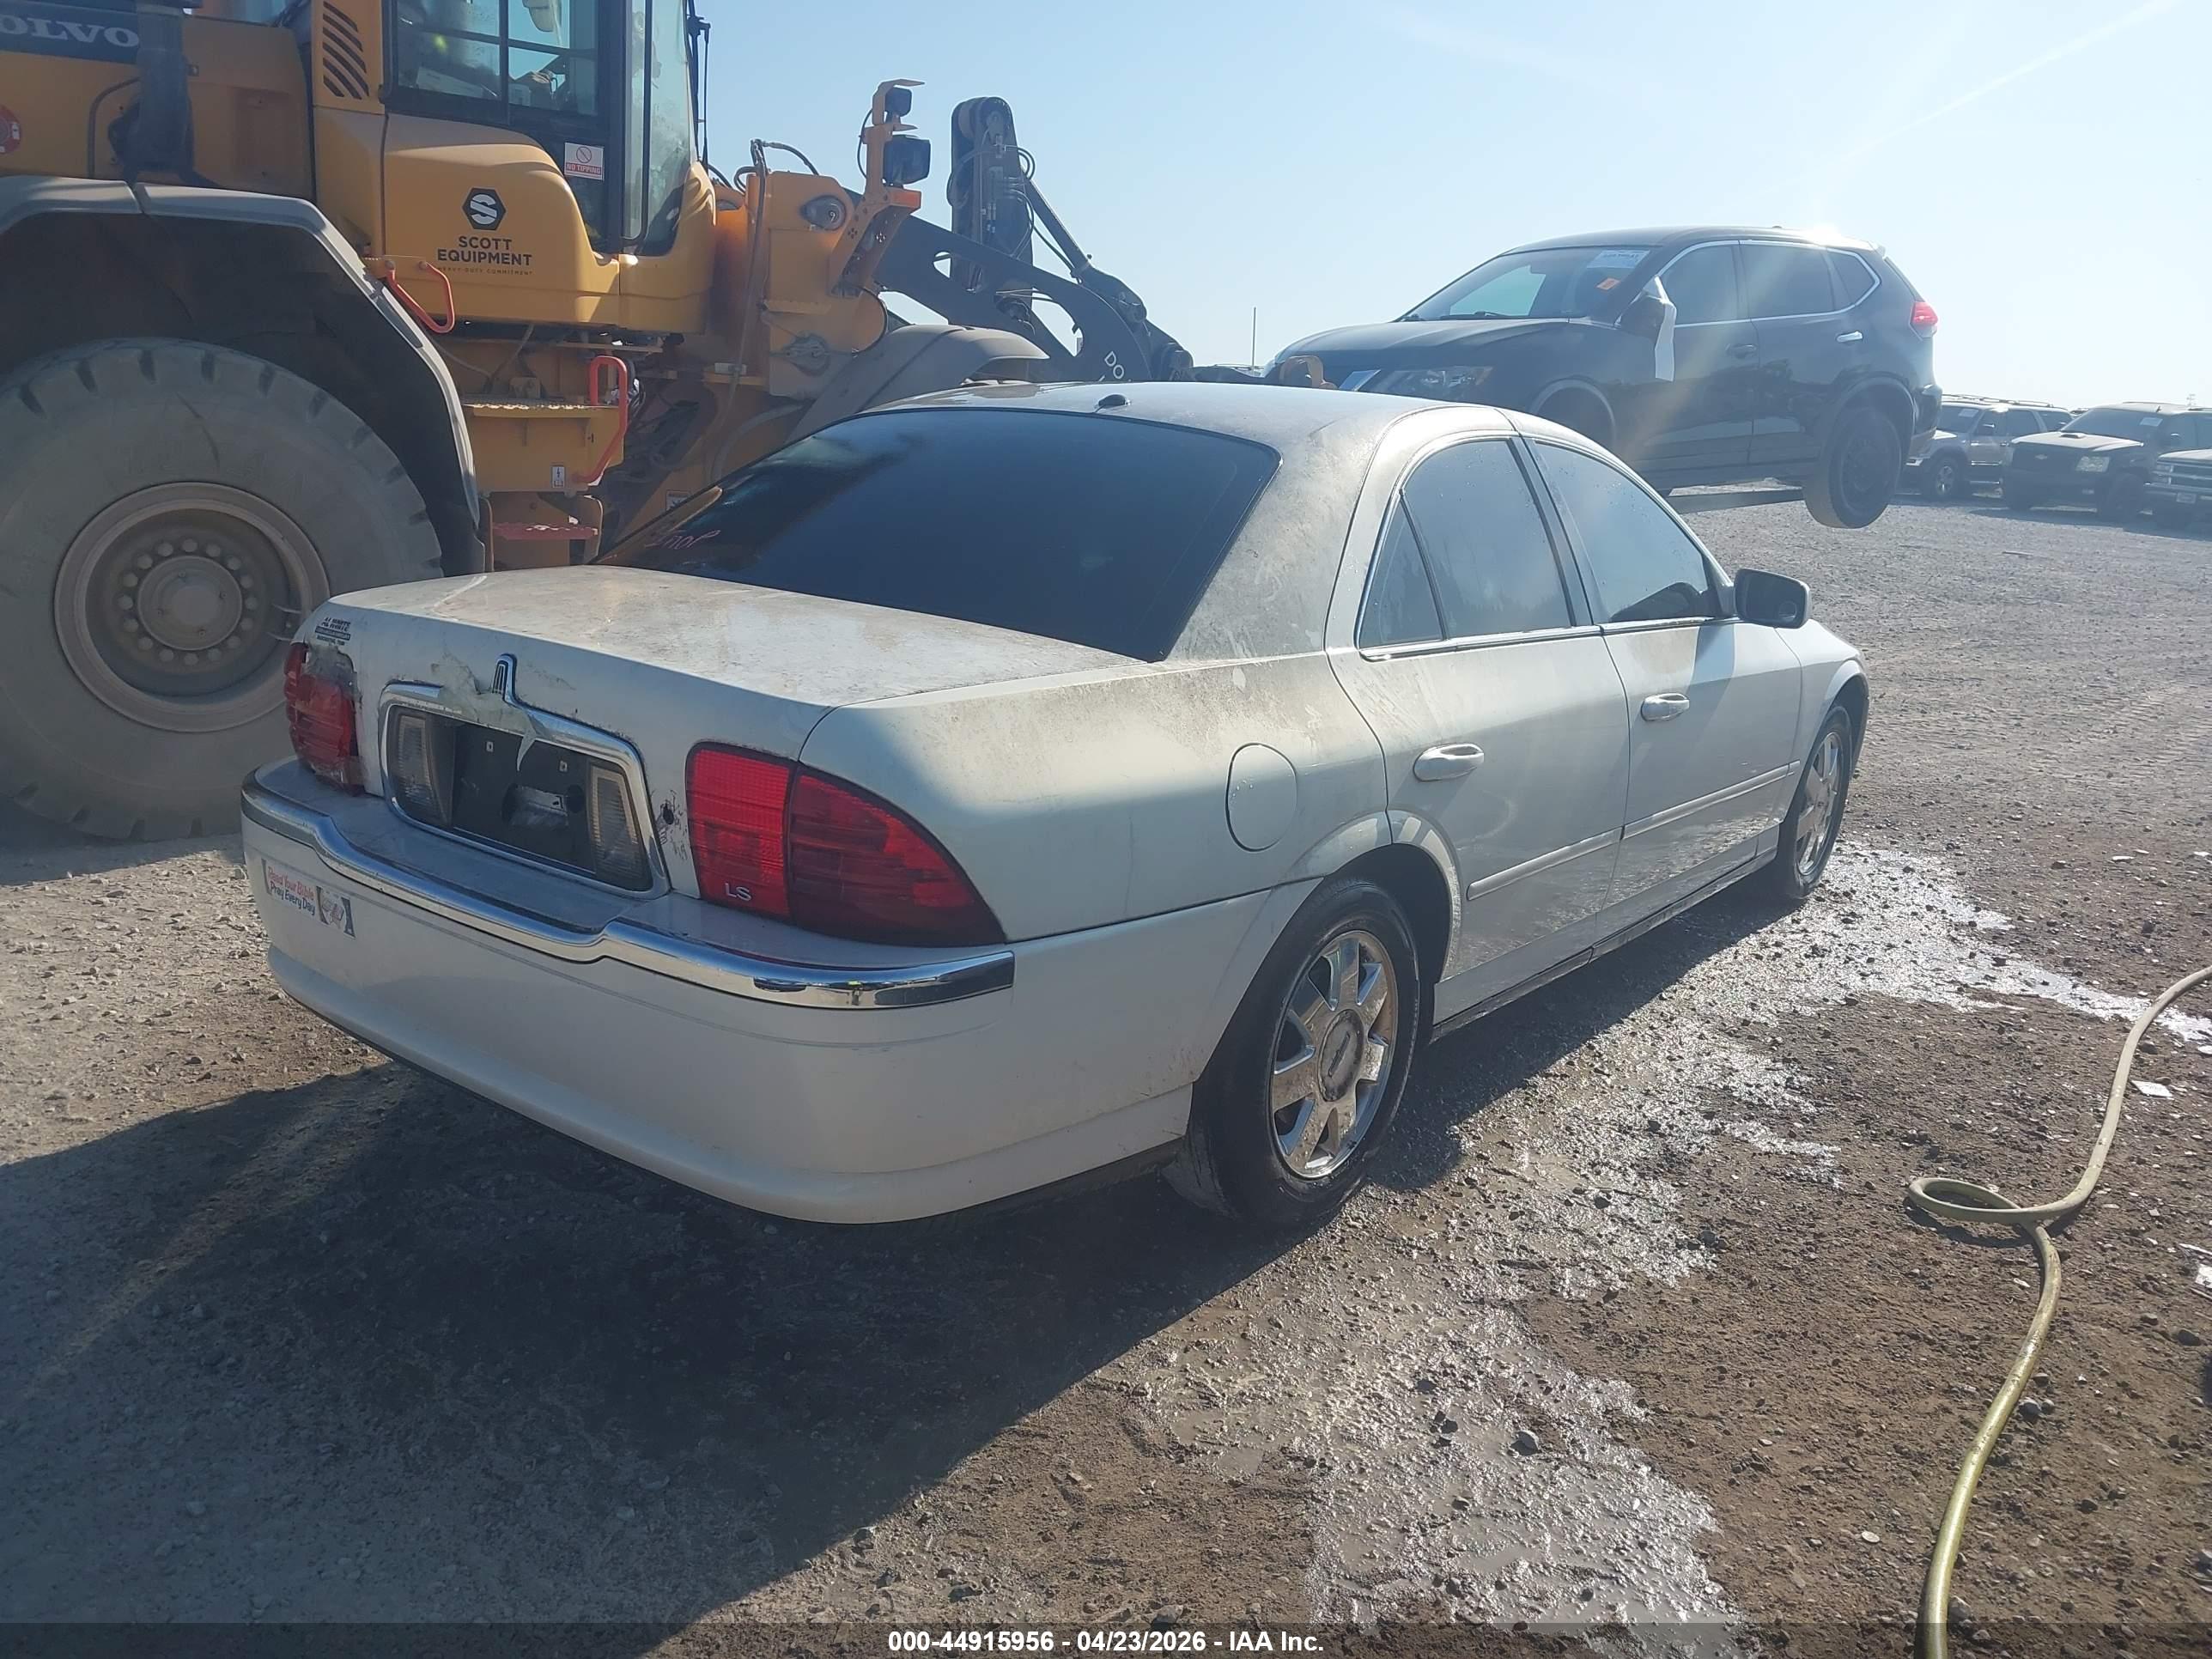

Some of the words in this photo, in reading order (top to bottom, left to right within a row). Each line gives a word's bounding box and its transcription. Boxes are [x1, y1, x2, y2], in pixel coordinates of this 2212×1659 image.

[567, 163, 576, 172] NO
[577, 164, 601, 174] TIPPING
[459, 236, 513, 250] SCOTT
[437, 249, 532, 265] EQUIPMENT
[268, 866, 283, 885] Read
[283, 873, 296, 890] Your
[296, 881, 314, 900] Bible
[270, 880, 284, 900] Pray
[284, 889, 301, 908] Every
[302, 897, 315, 915] Day
[725, 883, 752, 901] LS
